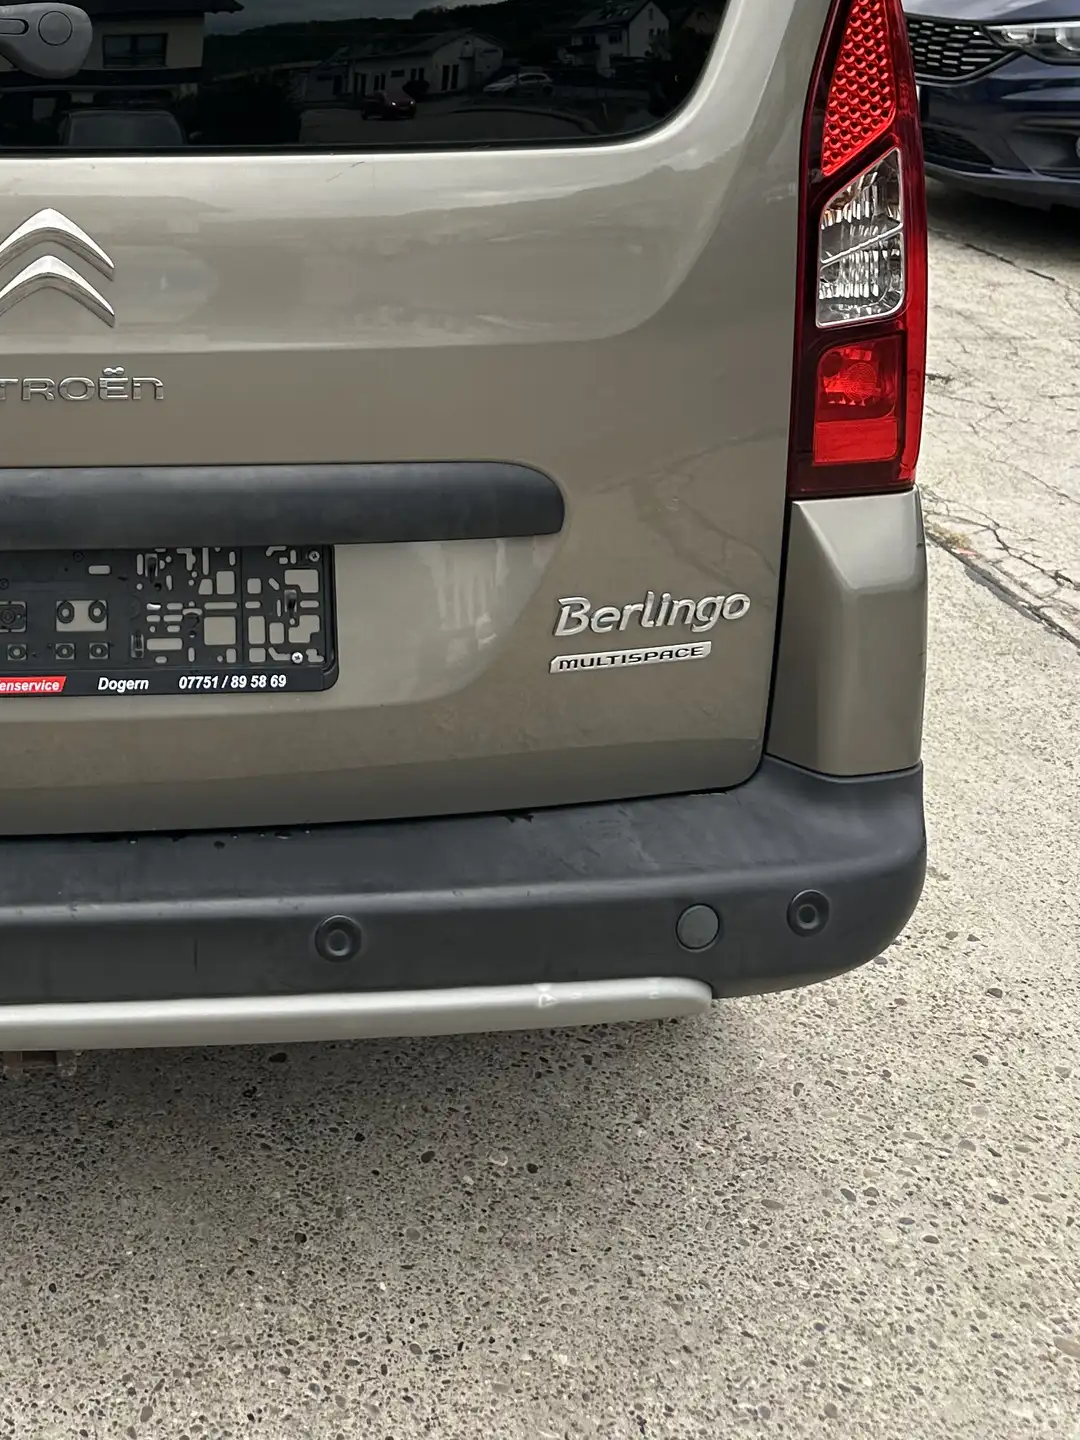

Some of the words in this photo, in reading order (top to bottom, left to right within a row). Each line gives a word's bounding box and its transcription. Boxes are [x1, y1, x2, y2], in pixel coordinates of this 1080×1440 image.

[553, 590, 751, 637] Berlingo
[559, 645, 705, 671] MULTISPACE
[97, 677, 149, 693] Dogern
[179, 676, 218, 689] 07751
[230, 675, 247, 688] 89
[250, 675, 267, 688] 58
[270, 674, 286, 688] 69
